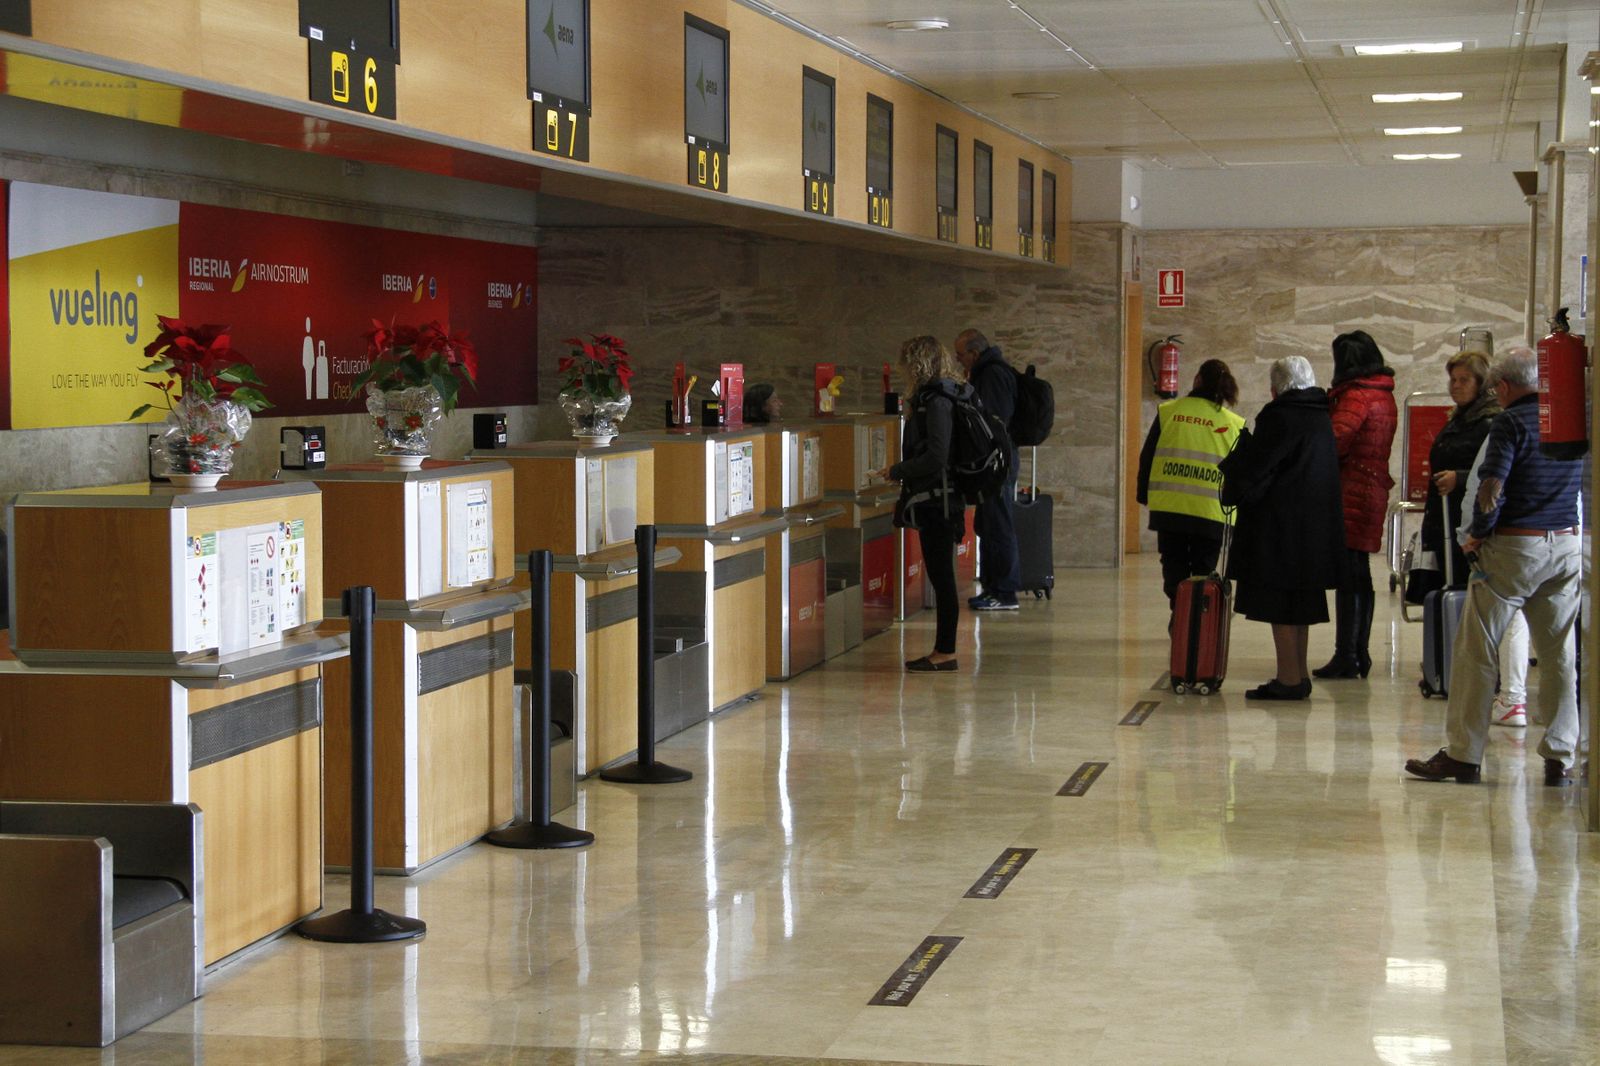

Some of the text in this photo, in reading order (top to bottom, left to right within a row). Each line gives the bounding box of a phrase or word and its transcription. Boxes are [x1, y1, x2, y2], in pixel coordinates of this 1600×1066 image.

[364, 57, 378, 113] 6
[568, 112, 577, 157] 7
[713, 152, 720, 190] 8
[822, 182, 829, 214] 9
[881, 197, 889, 228] 10
[188, 257, 309, 284] IBERIA AIRNOSTRUM
[382, 274, 413, 292] IBERIA
[189, 281, 214, 291] REGIONAL
[487, 282, 513, 298] IBERIA
[49, 269, 143, 345] vueling
[51, 373, 140, 389] LOVE THE WAY YOU FLY
[1173, 415, 1214, 427] IBERIA
